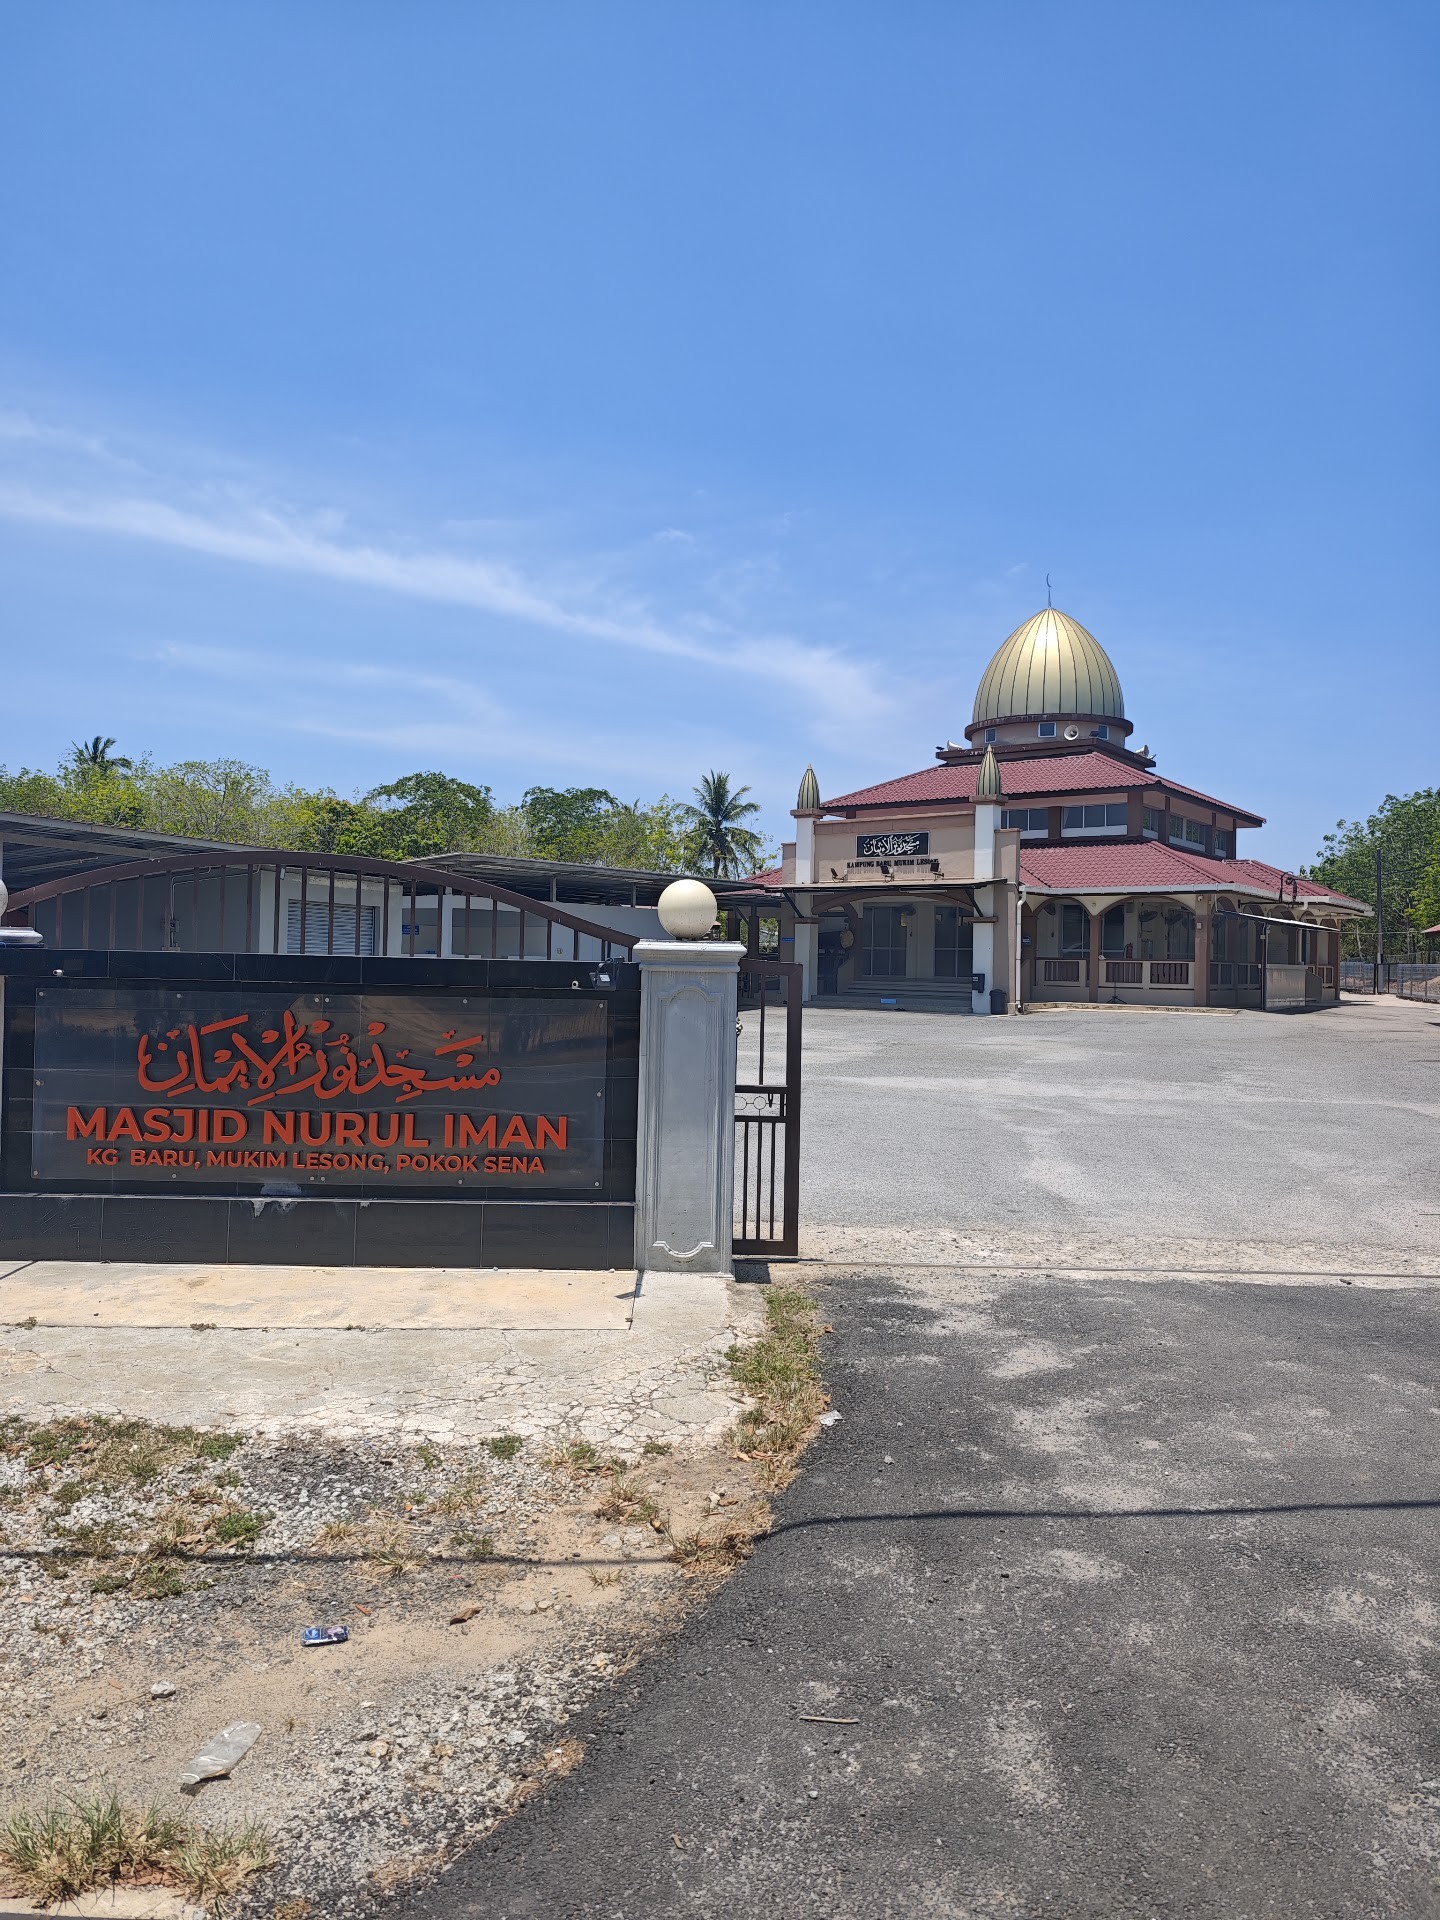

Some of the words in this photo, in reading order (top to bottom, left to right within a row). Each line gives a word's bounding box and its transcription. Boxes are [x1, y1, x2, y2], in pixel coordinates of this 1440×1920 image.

[66, 1107, 248, 1144] MASJID
[262, 1111, 430, 1148] NURUL
[443, 1115, 569, 1151] IMAN
[87, 1149, 119, 1166] KG
[130, 1149, 201, 1170] BARU,
[207, 1151, 287, 1168] MUKIM
[293, 1152, 391, 1174] LESONG,
[397, 1154, 478, 1173] POKOK
[484, 1156, 545, 1174] SENA
